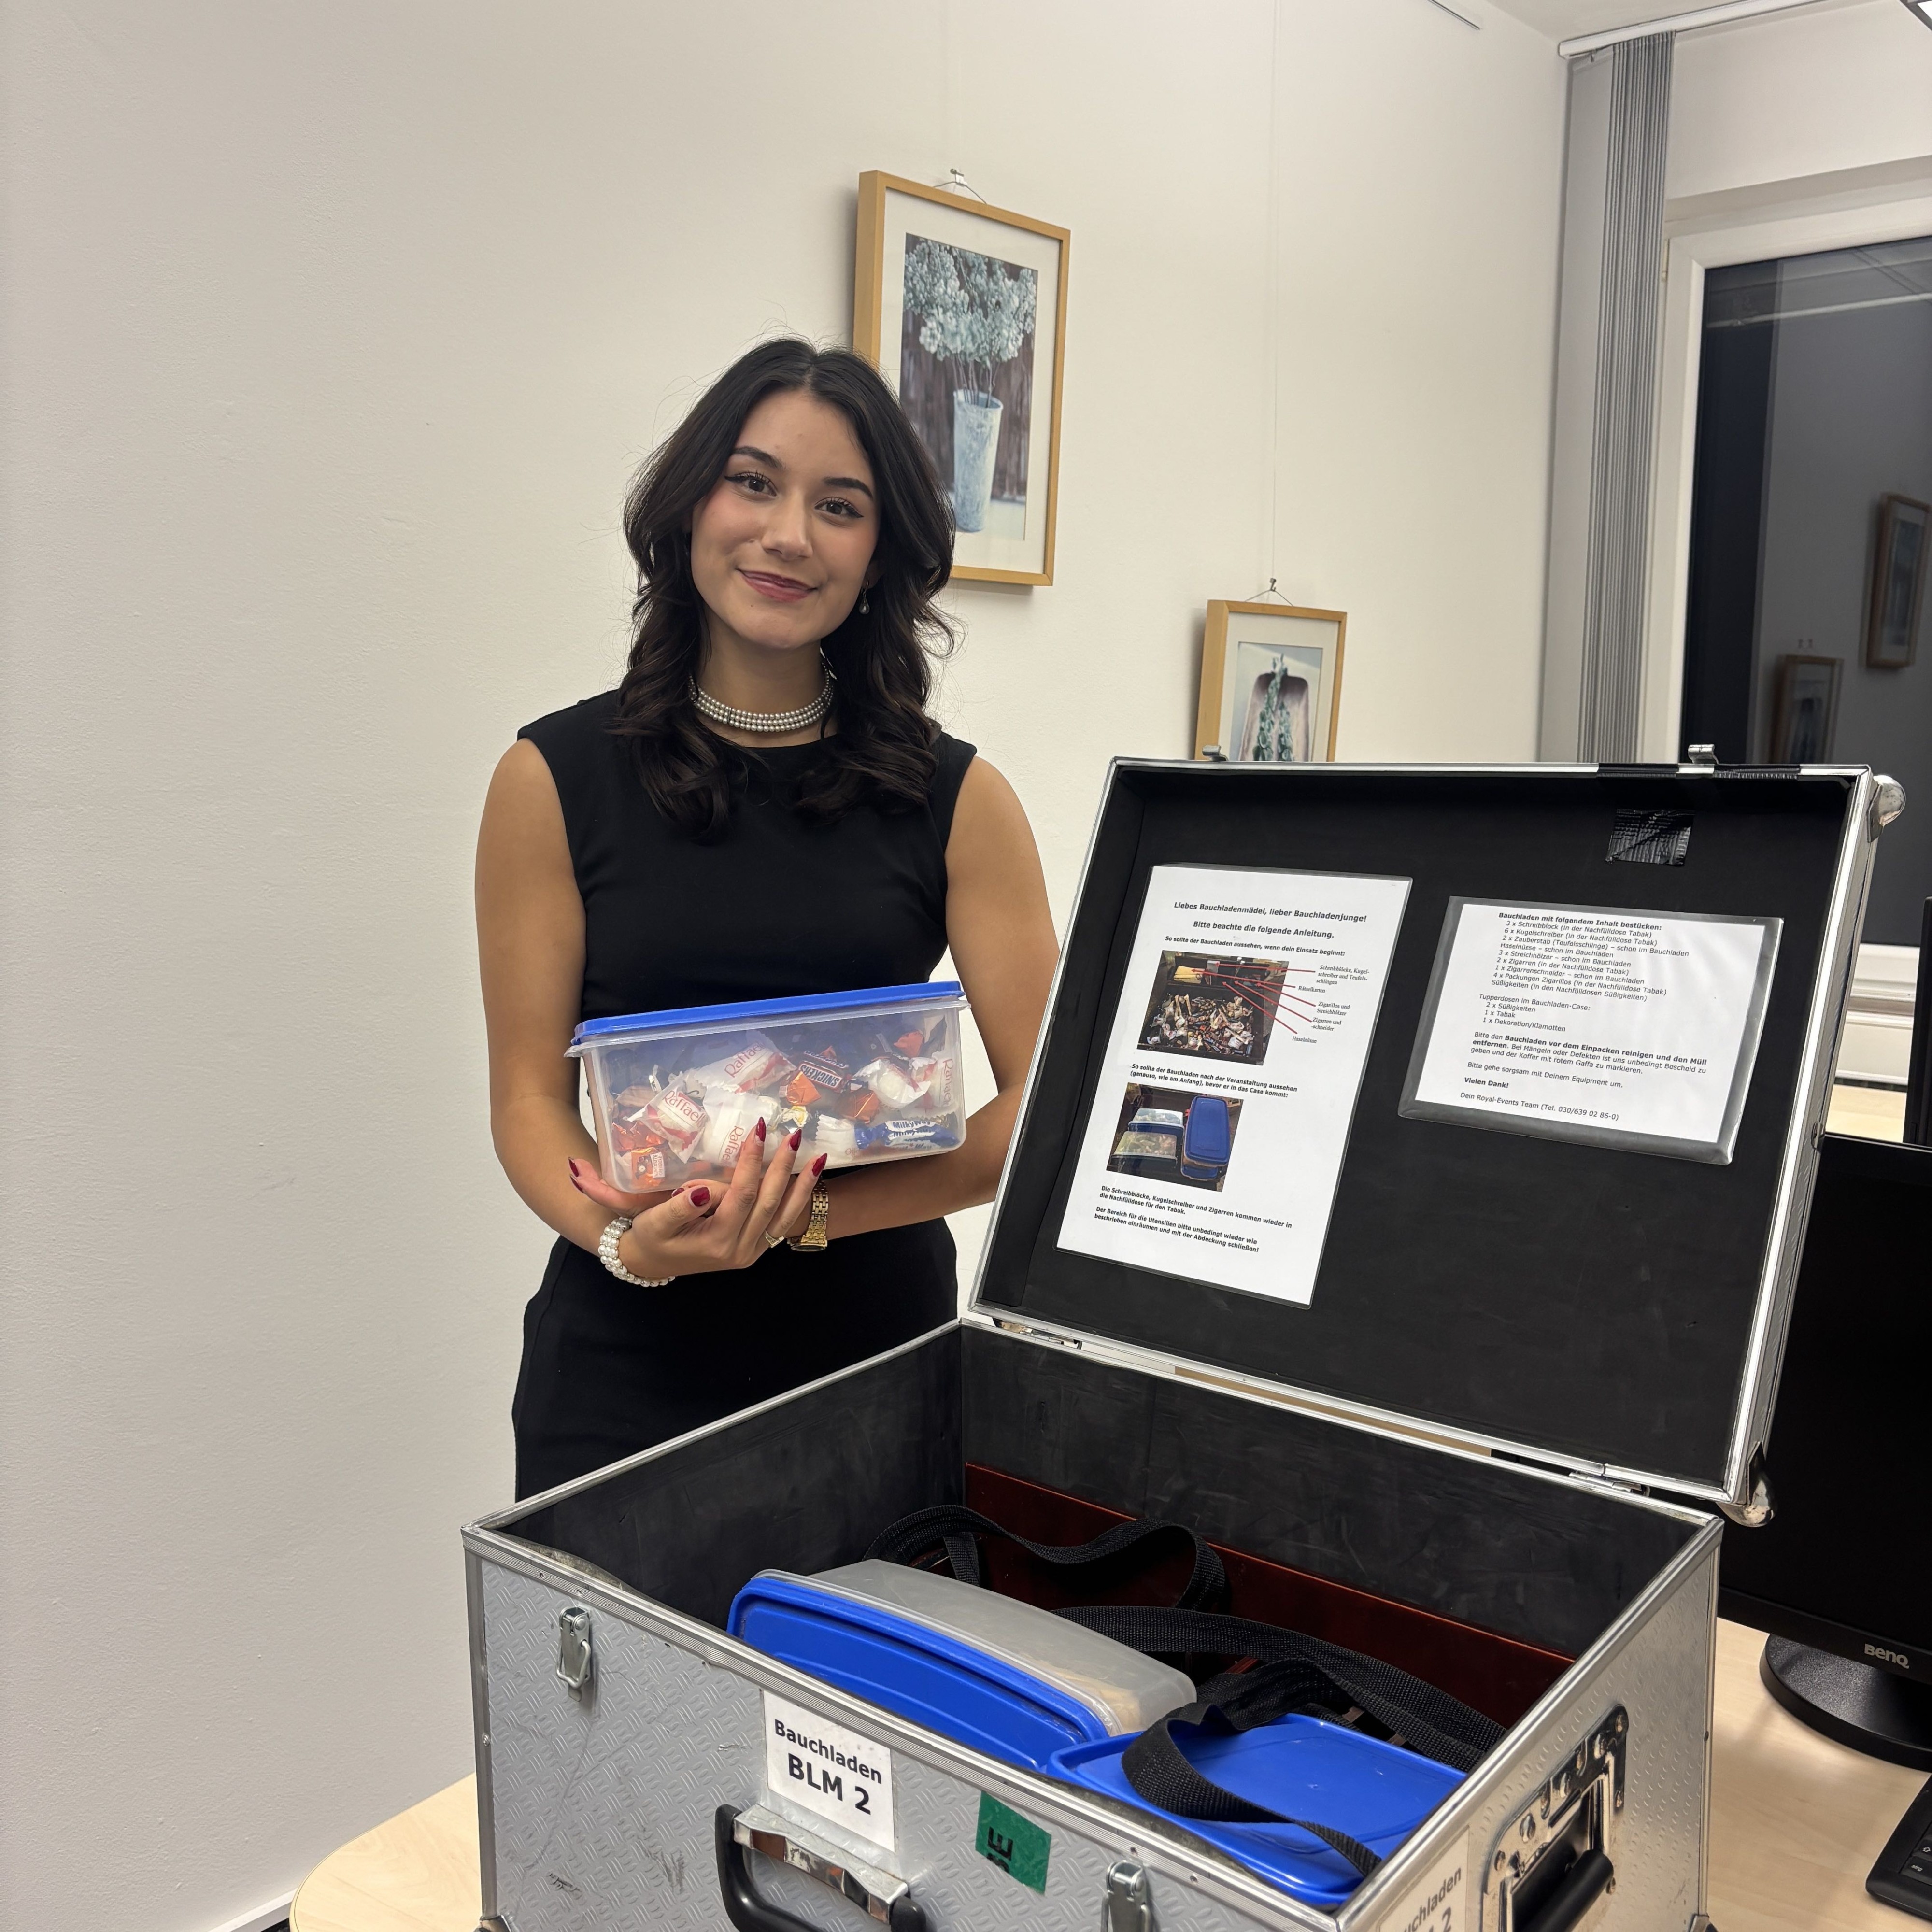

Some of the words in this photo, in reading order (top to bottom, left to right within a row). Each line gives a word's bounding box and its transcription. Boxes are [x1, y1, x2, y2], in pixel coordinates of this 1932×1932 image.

[1173, 901, 1198, 910] Liebes
[1199, 903, 1267, 916] Bauchladenmädel,
[1269, 908, 1293, 917] lieber
[1293, 909, 1367, 923] Bauchladenjunge!
[1498, 912, 1540, 921] Bauchladen
[1555, 916, 1594, 925] folgendem
[1595, 919, 1619, 927] Inhalt
[1620, 921, 1662, 931] bestücken:
[1193, 920, 1211, 929] Bitte
[1212, 922, 1243, 931] beachte
[1257, 925, 1292, 935] folgende
[1293, 928, 1335, 940] Anleitung.
[1200, 938, 1233, 947] Bauchladen
[1233, 942, 1263, 950] aussehen,
[1295, 946, 1319, 954] Einsatz
[1319, 948, 1346, 957] beginnt:
[1478, 993, 1520, 1003] Tupperdosen
[1531, 998, 1591, 1011] Bauchladen-Case:
[1491, 979, 1529, 989] Süßigkeiten
[1555, 986, 1603, 996] Nachfülldosen
[1604, 991, 1648, 1002] Süßigkeiten)
[1496, 1010, 1516, 1018] Tabak
[1497, 1002, 1536, 1013] Süßigkeiten
[1494, 1018, 1566, 1032] Dekoration/Klamotten
[1472, 1039, 1509, 1049] entfernen.
[1523, 1045, 1551, 1054] Mängeln
[1570, 1051, 1601, 1061] Defekten
[1627, 1059, 1663, 1069] unbedingt
[1663, 1063, 1696, 1073] Bescheid
[1474, 1031, 1490, 1039] Bitte
[1504, 1035, 1548, 1046] Bauchladen
[1562, 1042, 1580, 1050] dem
[1580, 1044, 1620, 1055] Einpacken
[1621, 1050, 1654, 1059] reinigen
[1673, 1055, 1688, 1064] den
[1690, 1057, 1707, 1066] Müll
[1467, 1061, 1483, 1069] Bitte
[1501, 1066, 1530, 1075] sorgsam
[1544, 1071, 1570, 1081] Deinem
[1571, 1075, 1609, 1086] Equipment
[1519, 1052, 1540, 1061] Koffer
[1553, 1056, 1574, 1065] rotem
[1575, 1059, 1594, 1068] Gaffa
[1605, 1064, 1643, 1074] markieren.
[800, 1065, 840, 1087] SNICKERS
[1130, 1069, 1157, 1080] (genauso,
[1179, 1077, 1204, 1087] Anfang),
[1205, 1080, 1222, 1089] bevor
[1249, 1087, 1264, 1095] Case
[1264, 1089, 1289, 1098] kommt:
[1166, 1068, 1199, 1078] Bauchladen
[1226, 1076, 1268, 1089] Veranstaltung
[1268, 1083, 1298, 1093] aussehen
[1464, 1077, 1487, 1086] Vielen
[1487, 1080, 1509, 1089] Dank!
[1460, 1092, 1475, 1100] Dein
[1476, 1094, 1520, 1106] Royal-Events
[1520, 1100, 1539, 1109] Team
[1540, 1103, 1556, 1111] (Tel.
[1558, 1106, 1588, 1116] 030/639
[1599, 1111, 1619, 1121] 86-0)
[1108, 1194, 1145, 1207] Nachfülldose
[1167, 1205, 1186, 1215] Tabak.
[1110, 1187, 1151, 1201] Schreibblöcke,
[1151, 1195, 1195, 1209] Kugelschreiber
[1208, 1206, 1234, 1217] Zigarren
[1235, 1211, 1262, 1223] kommen
[1263, 1218, 1285, 1227] wieder
[1094, 1212, 1127, 1225] beschrieben
[1127, 1220, 1158, 1232] einräumen
[1193, 1234, 1227, 1247] Abdeckung
[1227, 1242, 1260, 1253] schließen!
[1107, 1208, 1128, 1218] Bereich
[1148, 1216, 1177, 1228] Utensilien
[1177, 1222, 1192, 1231] bitte
[1192, 1227, 1223, 1238] unbedingt
[1223, 1233, 1246, 1242] wieder
[1864, 1643, 1910, 1669] BenQ
[775, 1719, 881, 1784] Bauchladen
[788, 1753, 843, 1801] BLM
[855, 1786, 871, 1815] 2
